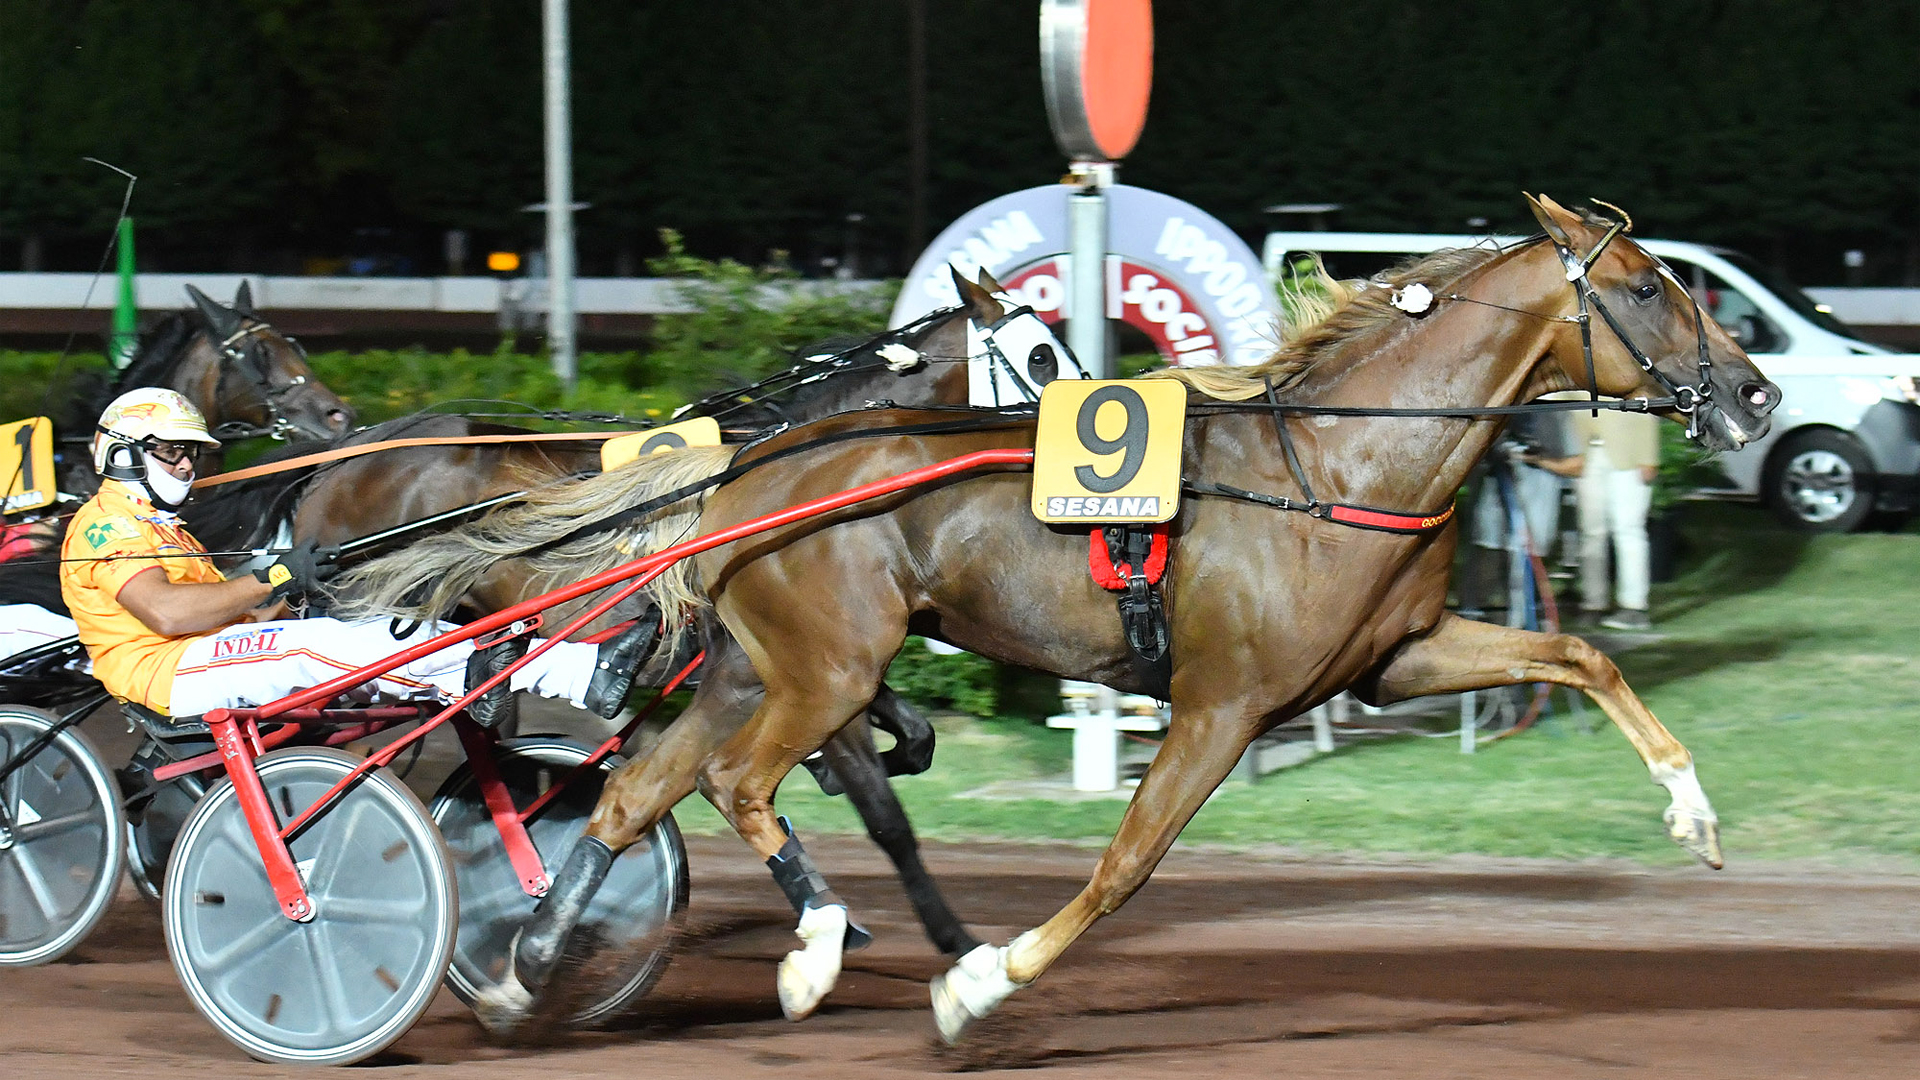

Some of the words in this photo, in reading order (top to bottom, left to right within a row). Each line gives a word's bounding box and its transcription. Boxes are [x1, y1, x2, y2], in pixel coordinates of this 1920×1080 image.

[1153, 217, 1279, 366] IPPODRO
[1074, 385, 1149, 494] 9
[1047, 497, 1159, 517] SESANA
[213, 633, 279, 658] INDAL
